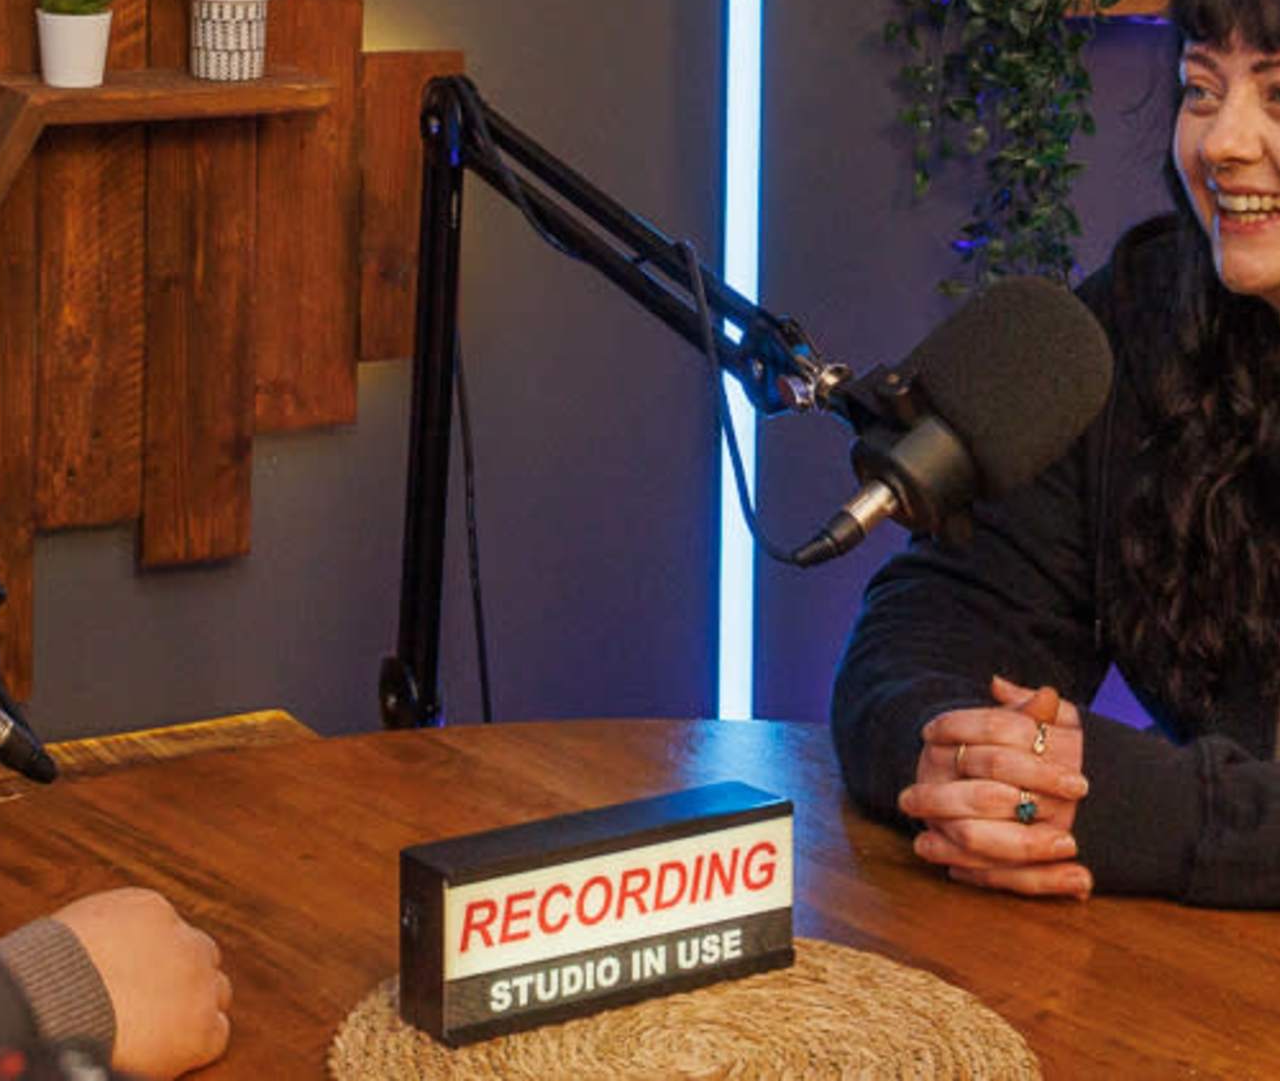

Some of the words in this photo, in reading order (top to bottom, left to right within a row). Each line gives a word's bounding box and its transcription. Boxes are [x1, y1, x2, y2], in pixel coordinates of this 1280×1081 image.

[459, 841, 778, 953] RECORDING
[489, 955, 620, 1012] STUDIO
[631, 944, 667, 982] IN
[678, 928, 744, 969] USE
